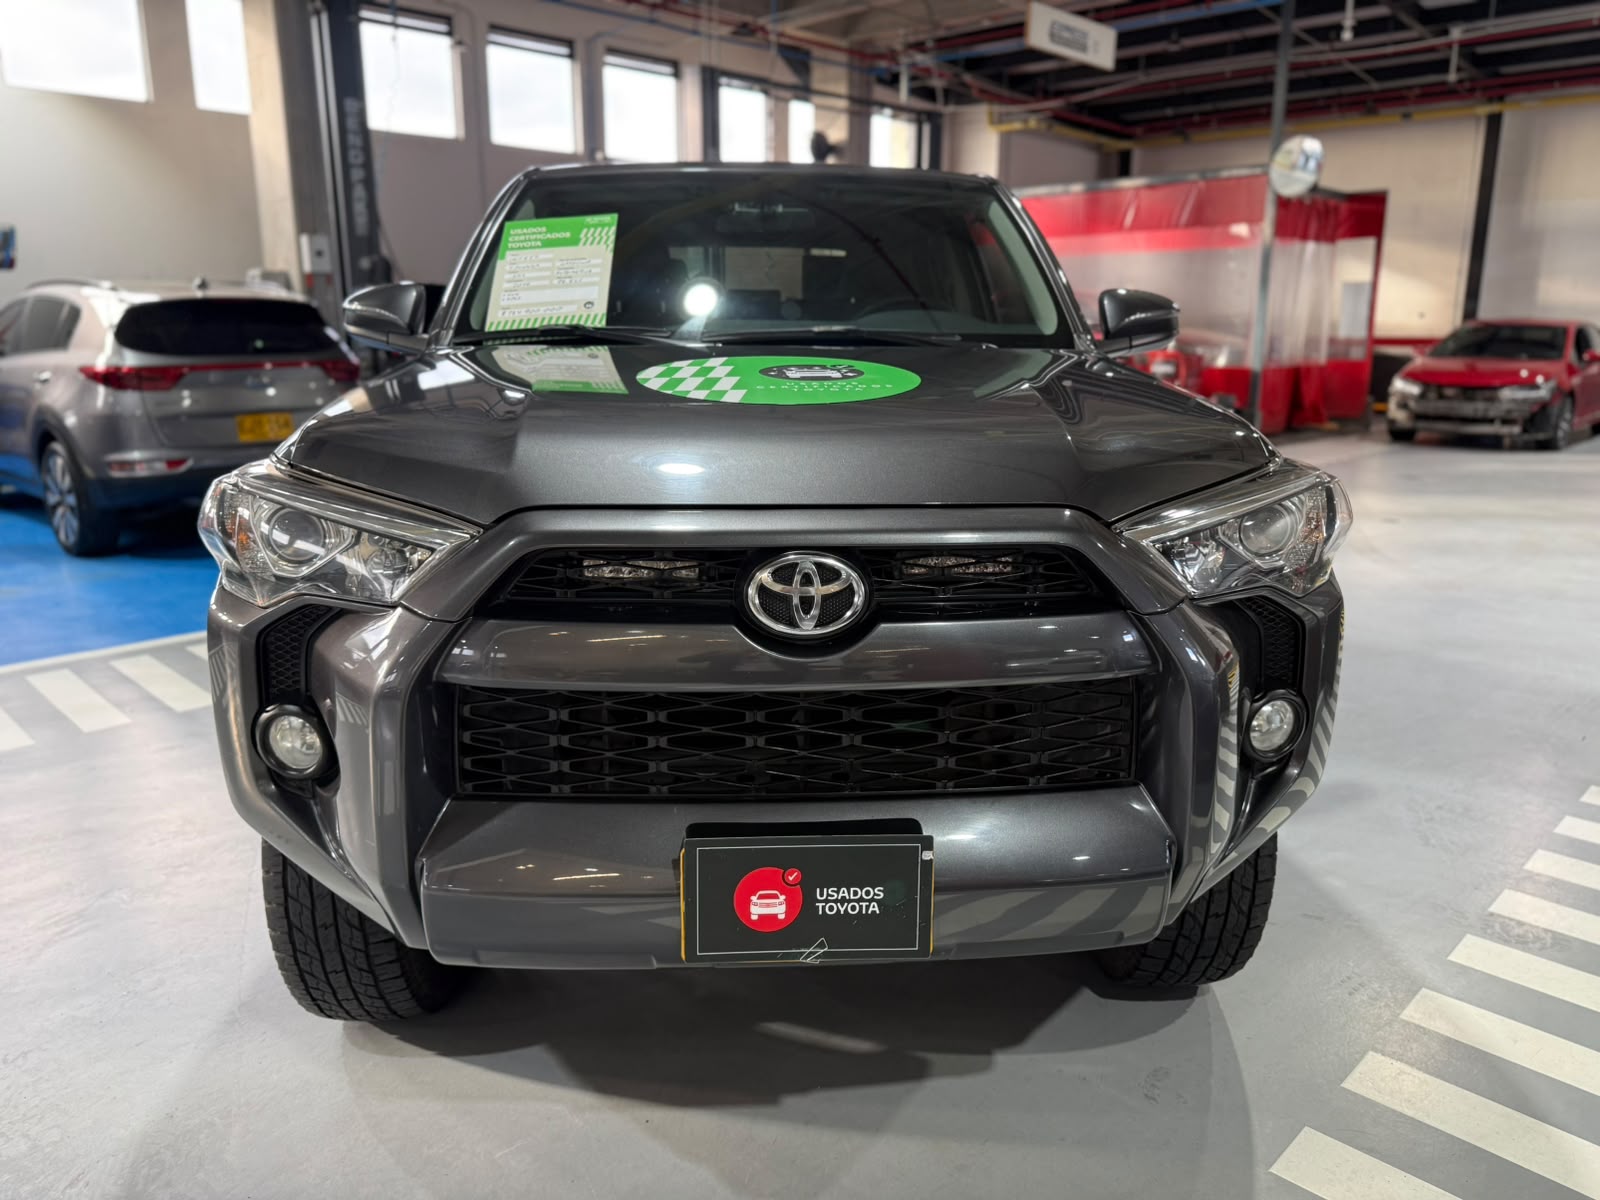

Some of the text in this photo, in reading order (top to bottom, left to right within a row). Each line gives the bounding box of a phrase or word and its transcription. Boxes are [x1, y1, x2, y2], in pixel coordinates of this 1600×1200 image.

[510, 227, 547, 235] USADOS
[508, 232, 571, 241] CERTIFICADOS
[508, 240, 542, 248] TOYOTA
[816, 887, 884, 900] USADOS
[815, 902, 880, 915] TOYOTA
